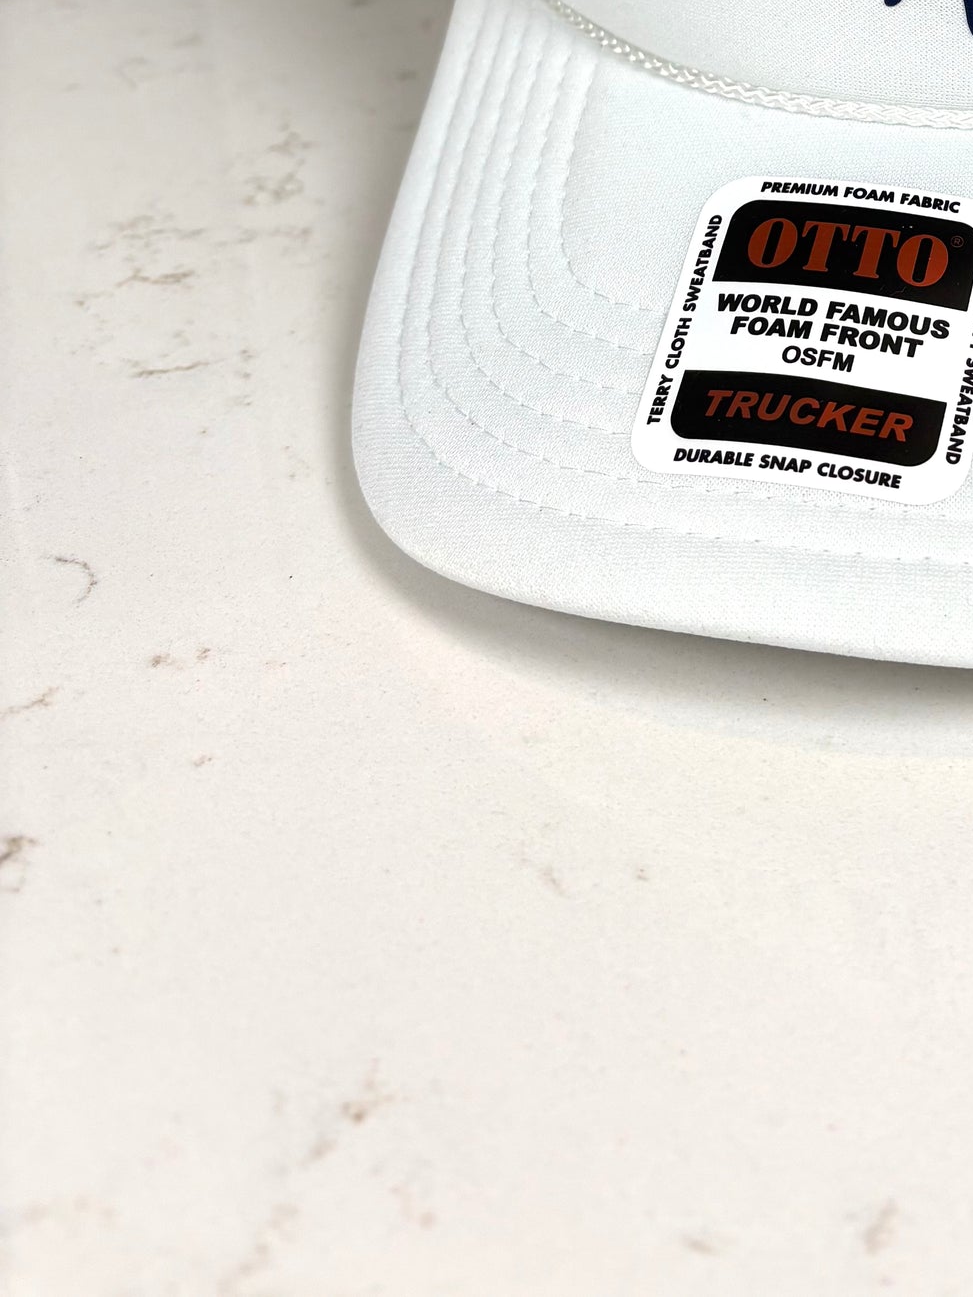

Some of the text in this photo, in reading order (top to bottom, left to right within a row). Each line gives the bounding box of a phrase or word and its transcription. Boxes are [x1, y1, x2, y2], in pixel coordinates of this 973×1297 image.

[760, 181, 961, 214] PREMIUM FOAM FABRIC
[646, 214, 723, 425] TERRY CLOTH SWEATBAND
[717, 293, 950, 339] WORLD FAMOUS
[730, 316, 923, 358] FOAM FRONT
[781, 345, 855, 373] OSFM
[703, 389, 914, 442] TRUCKER
[673, 448, 902, 490] DURABLE SNAP CLOSURE
